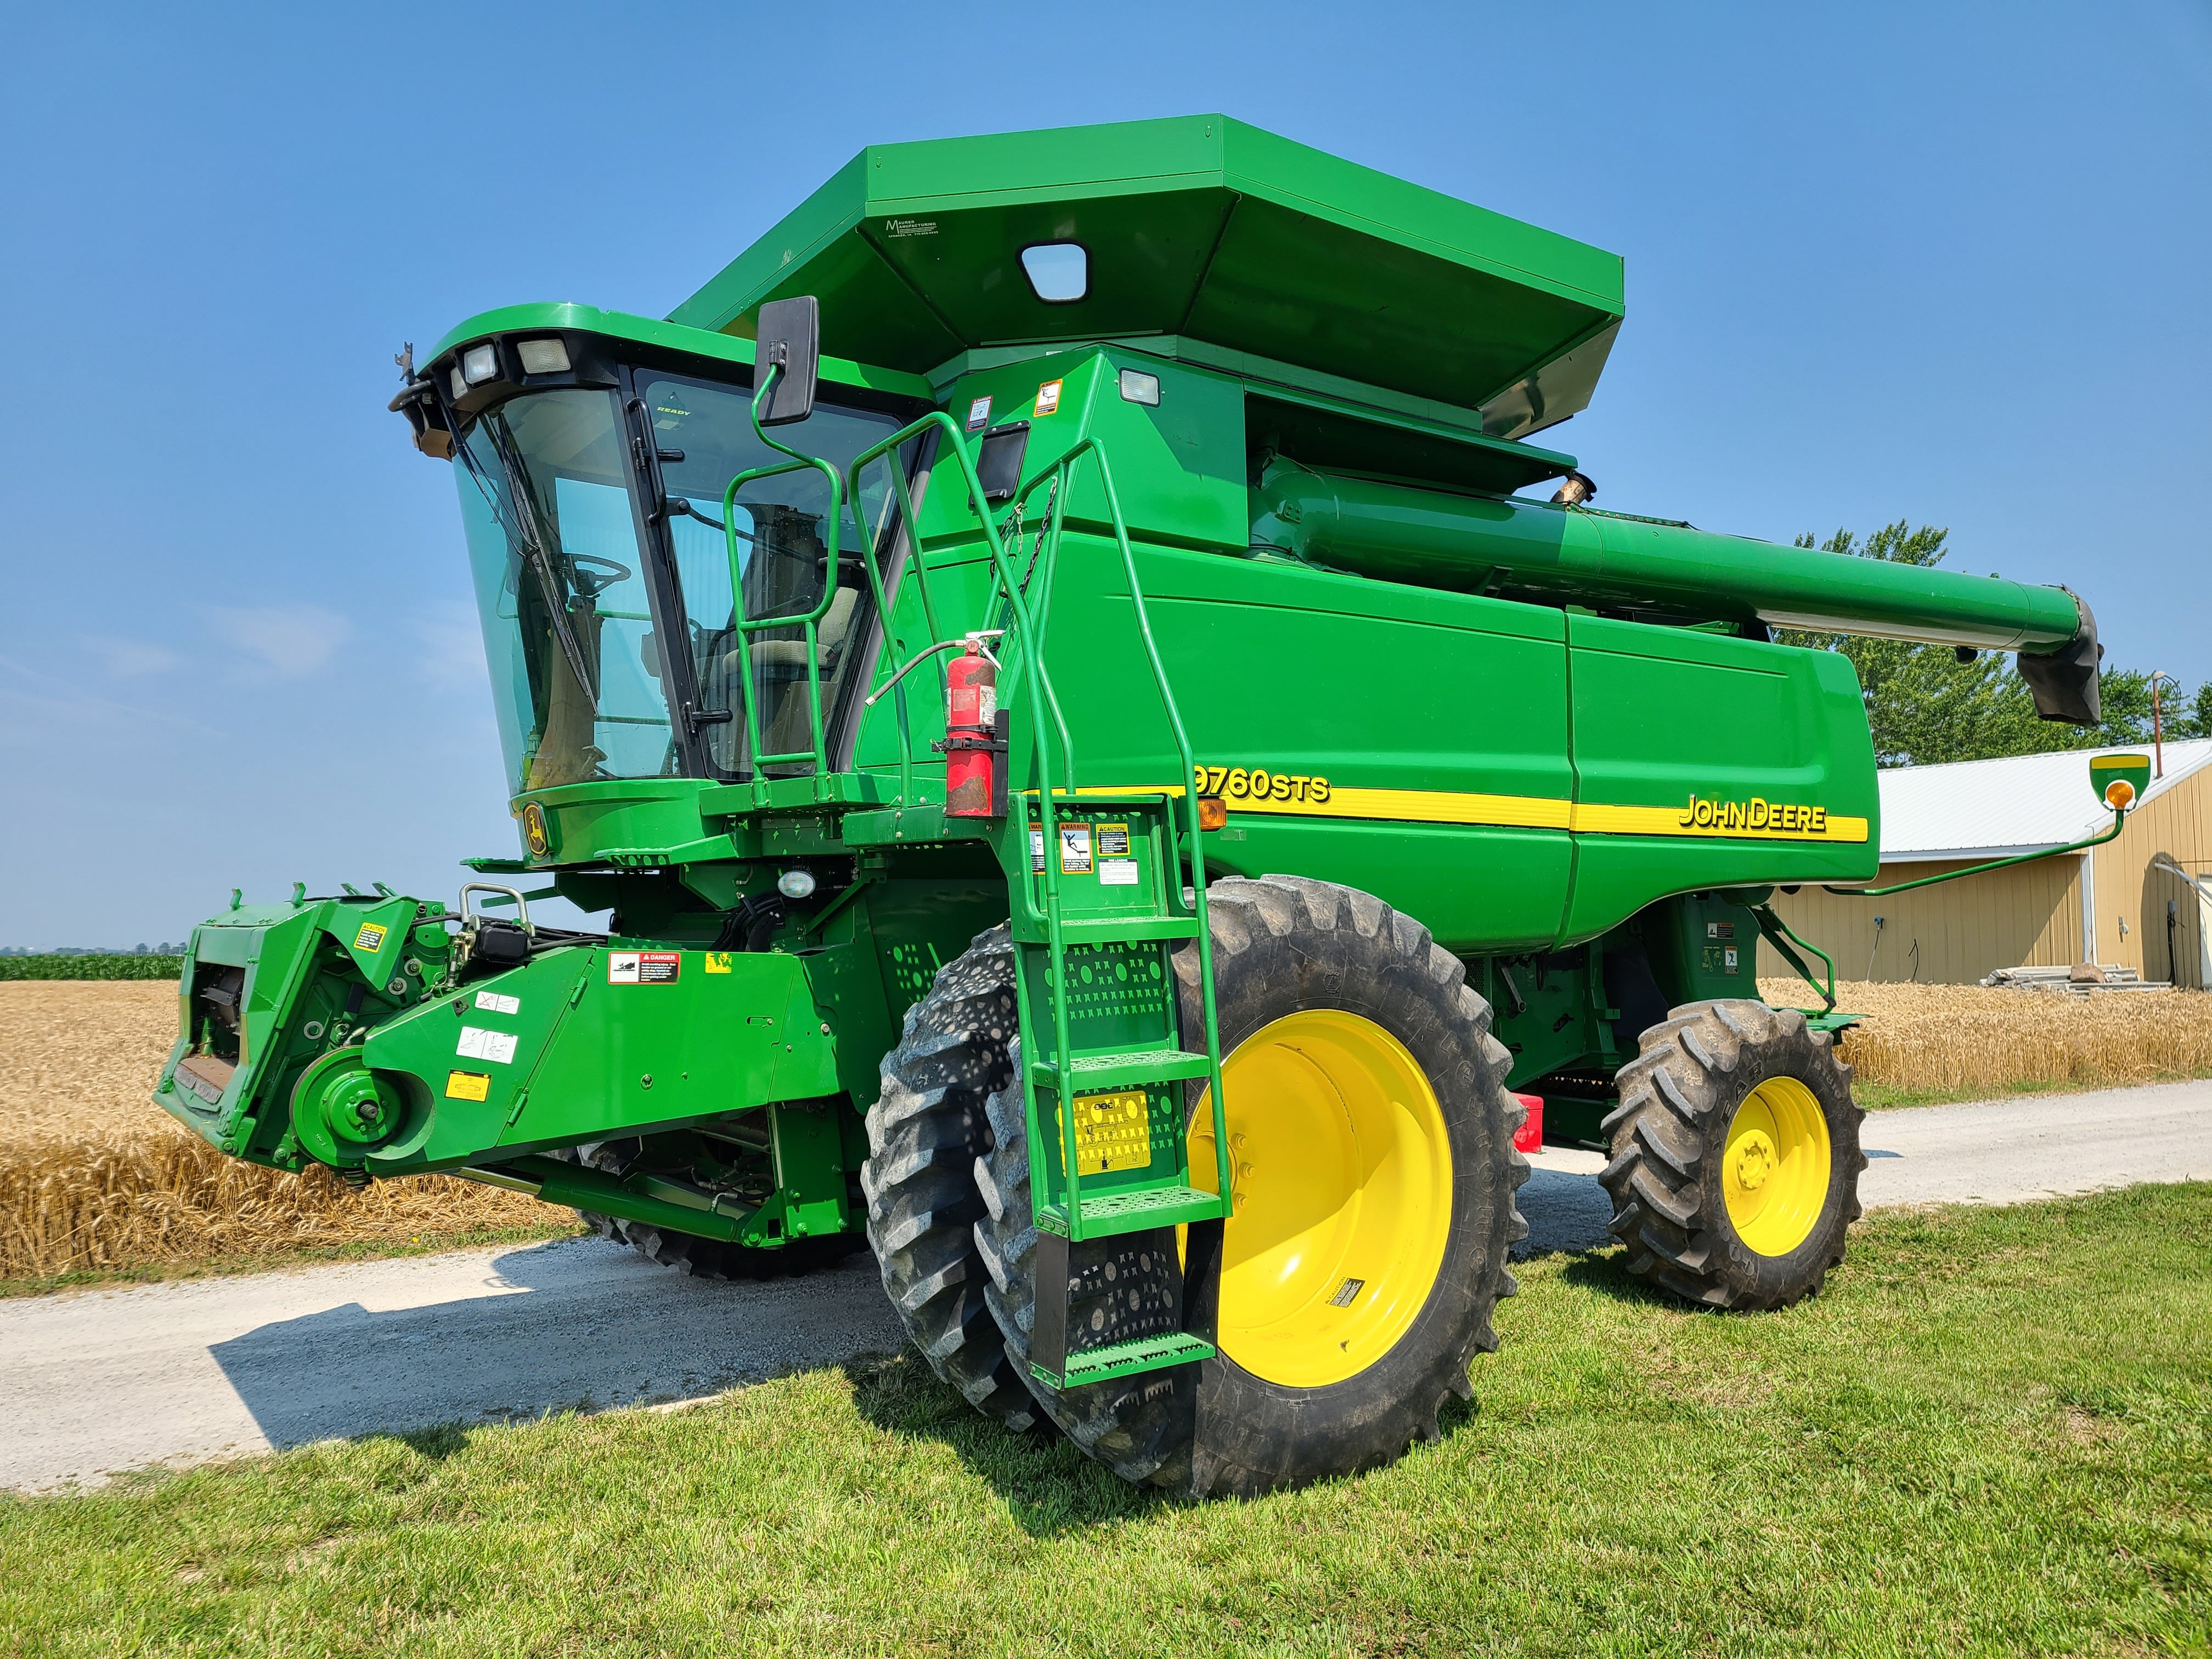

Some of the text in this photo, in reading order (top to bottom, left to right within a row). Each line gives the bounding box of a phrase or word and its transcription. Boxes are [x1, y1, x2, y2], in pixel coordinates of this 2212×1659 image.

[657, 407, 691, 416] READY
[1194, 764, 1331, 804] 9760STS
[1679, 794, 1827, 833] JOHN DEERE
[366, 924, 386, 933] CAUTION
[1328, 1277, 1346, 1299] CAUTION
